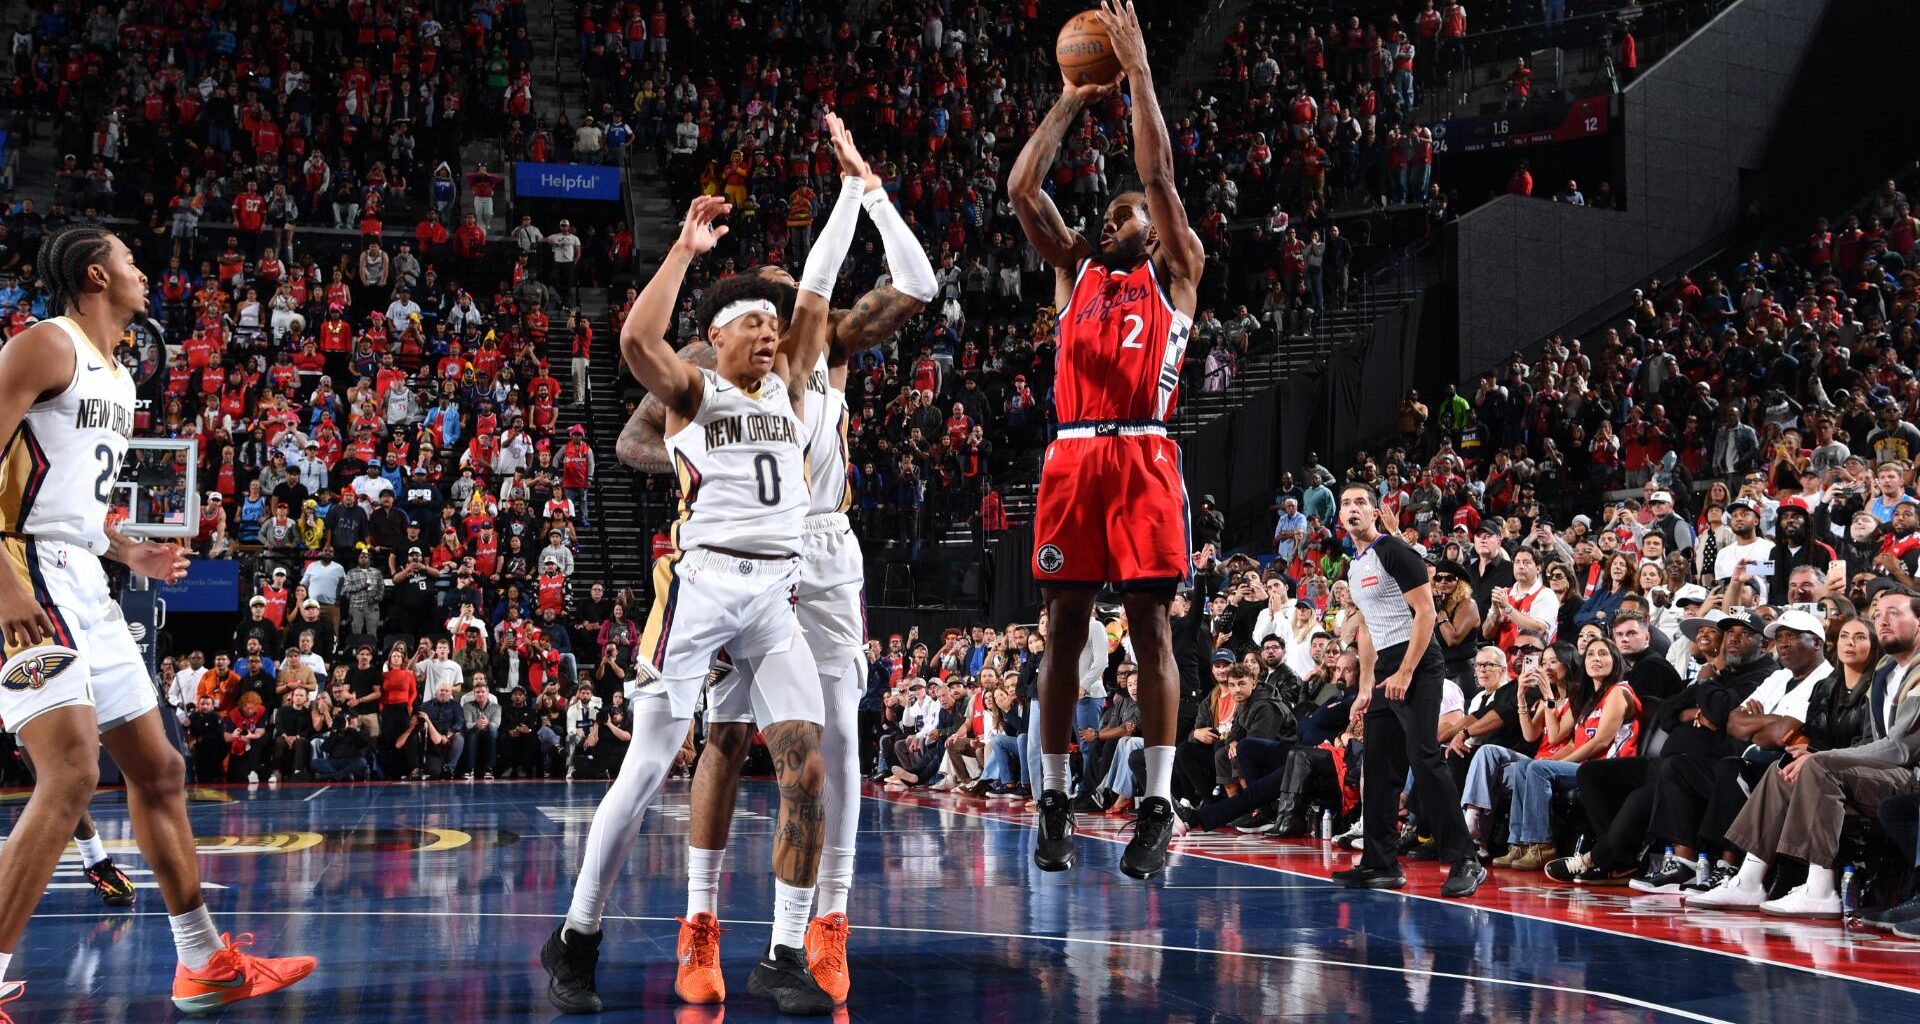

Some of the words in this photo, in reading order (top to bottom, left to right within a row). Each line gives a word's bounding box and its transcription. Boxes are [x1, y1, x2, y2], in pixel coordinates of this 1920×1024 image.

[1492, 120, 1509, 136] 1.6
[1584, 117, 1598, 132] 12
[1432, 139, 1448, 153] 24
[541, 174, 594, 192] Helpful
[245, 199, 261, 212] 87
[1122, 314, 1144, 349] 2
[76, 399, 110, 429] NEW
[704, 415, 742, 452] NEW
[754, 453, 782, 506] 0
